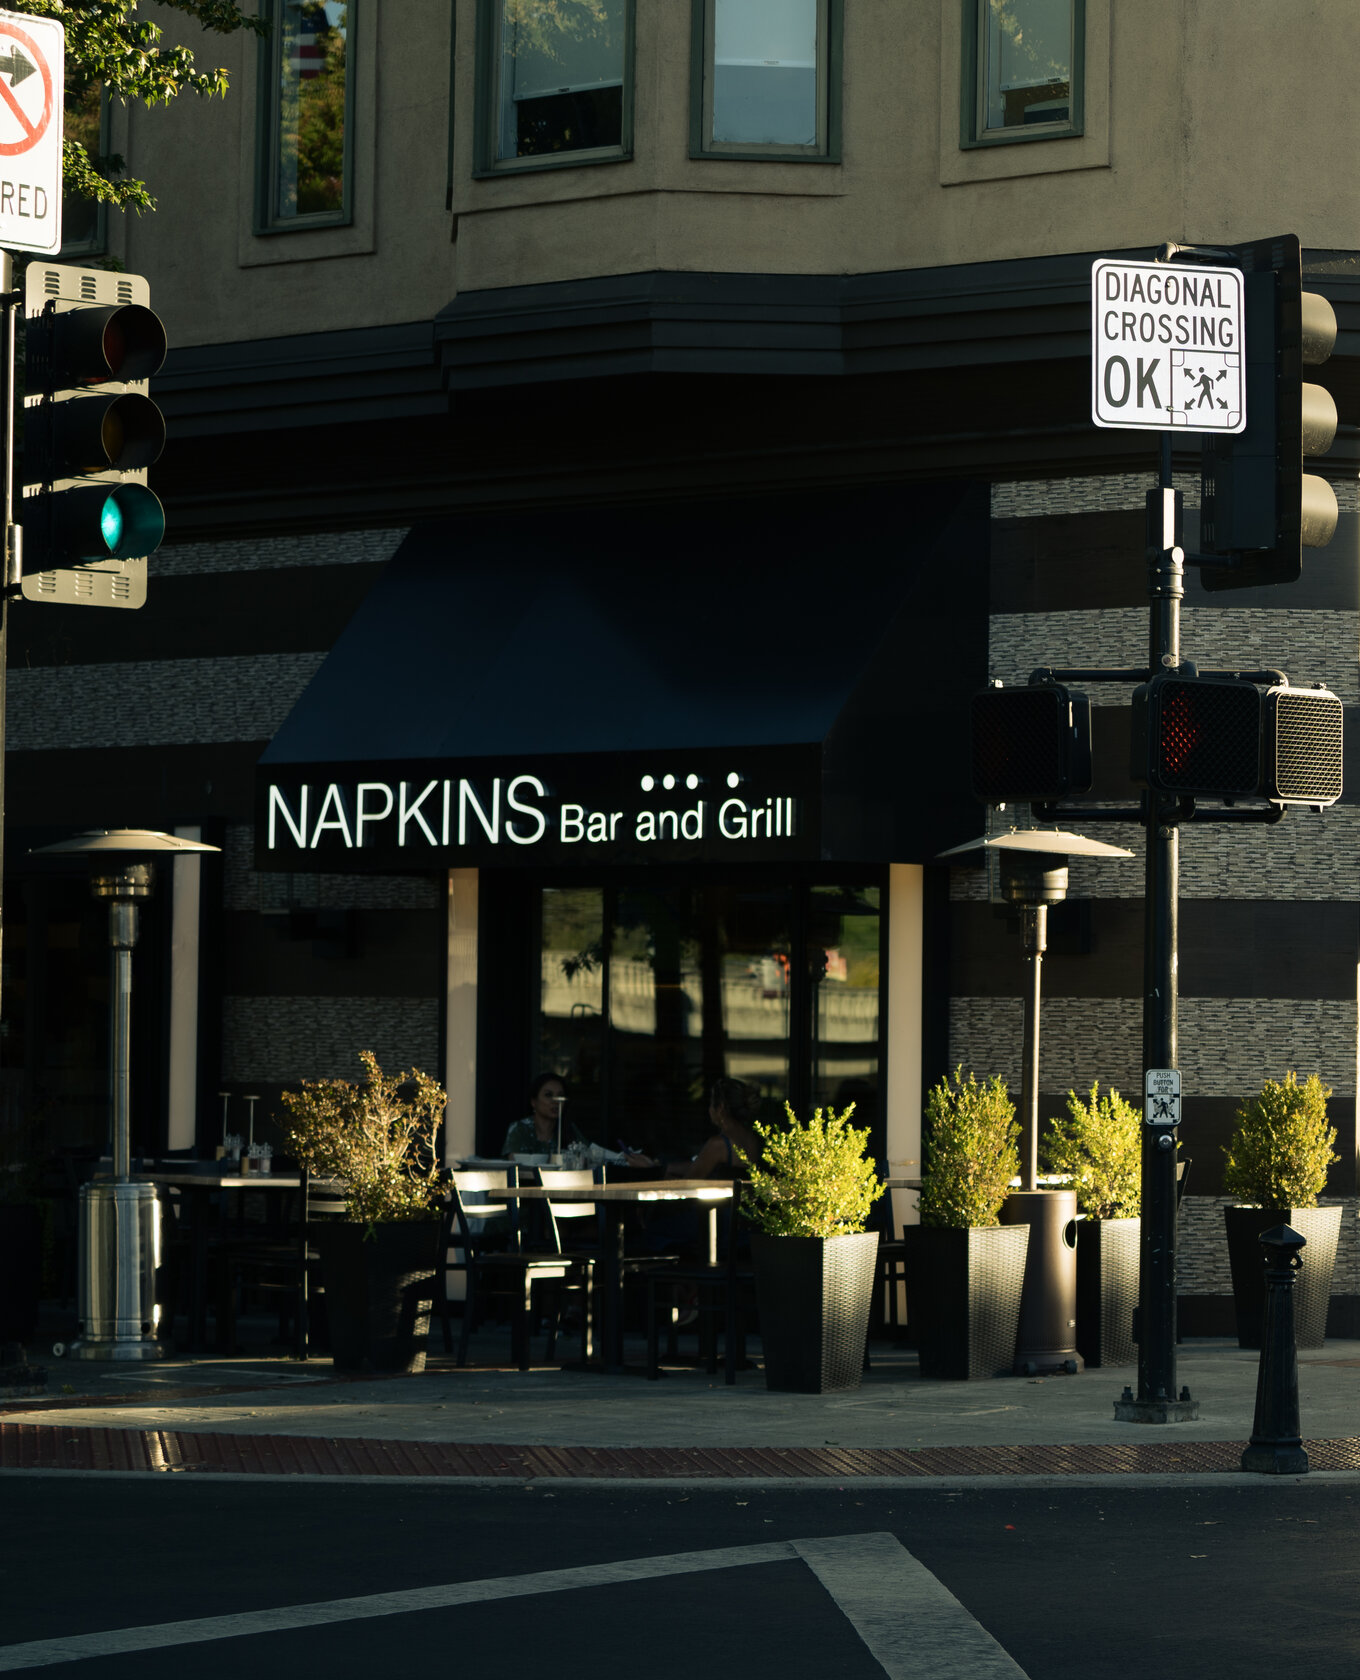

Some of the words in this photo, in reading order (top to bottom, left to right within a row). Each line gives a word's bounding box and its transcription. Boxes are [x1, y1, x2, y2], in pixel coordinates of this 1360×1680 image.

[1, 180, 48, 220] RED
[1105, 271, 1231, 309] DIAGONAL
[1104, 310, 1233, 348] CROSSING
[1103, 355, 1162, 409] OK
[268, 774, 546, 849] NAPKINS
[560, 803, 624, 843] Bar
[635, 800, 704, 842] and
[718, 797, 792, 839] Grill
